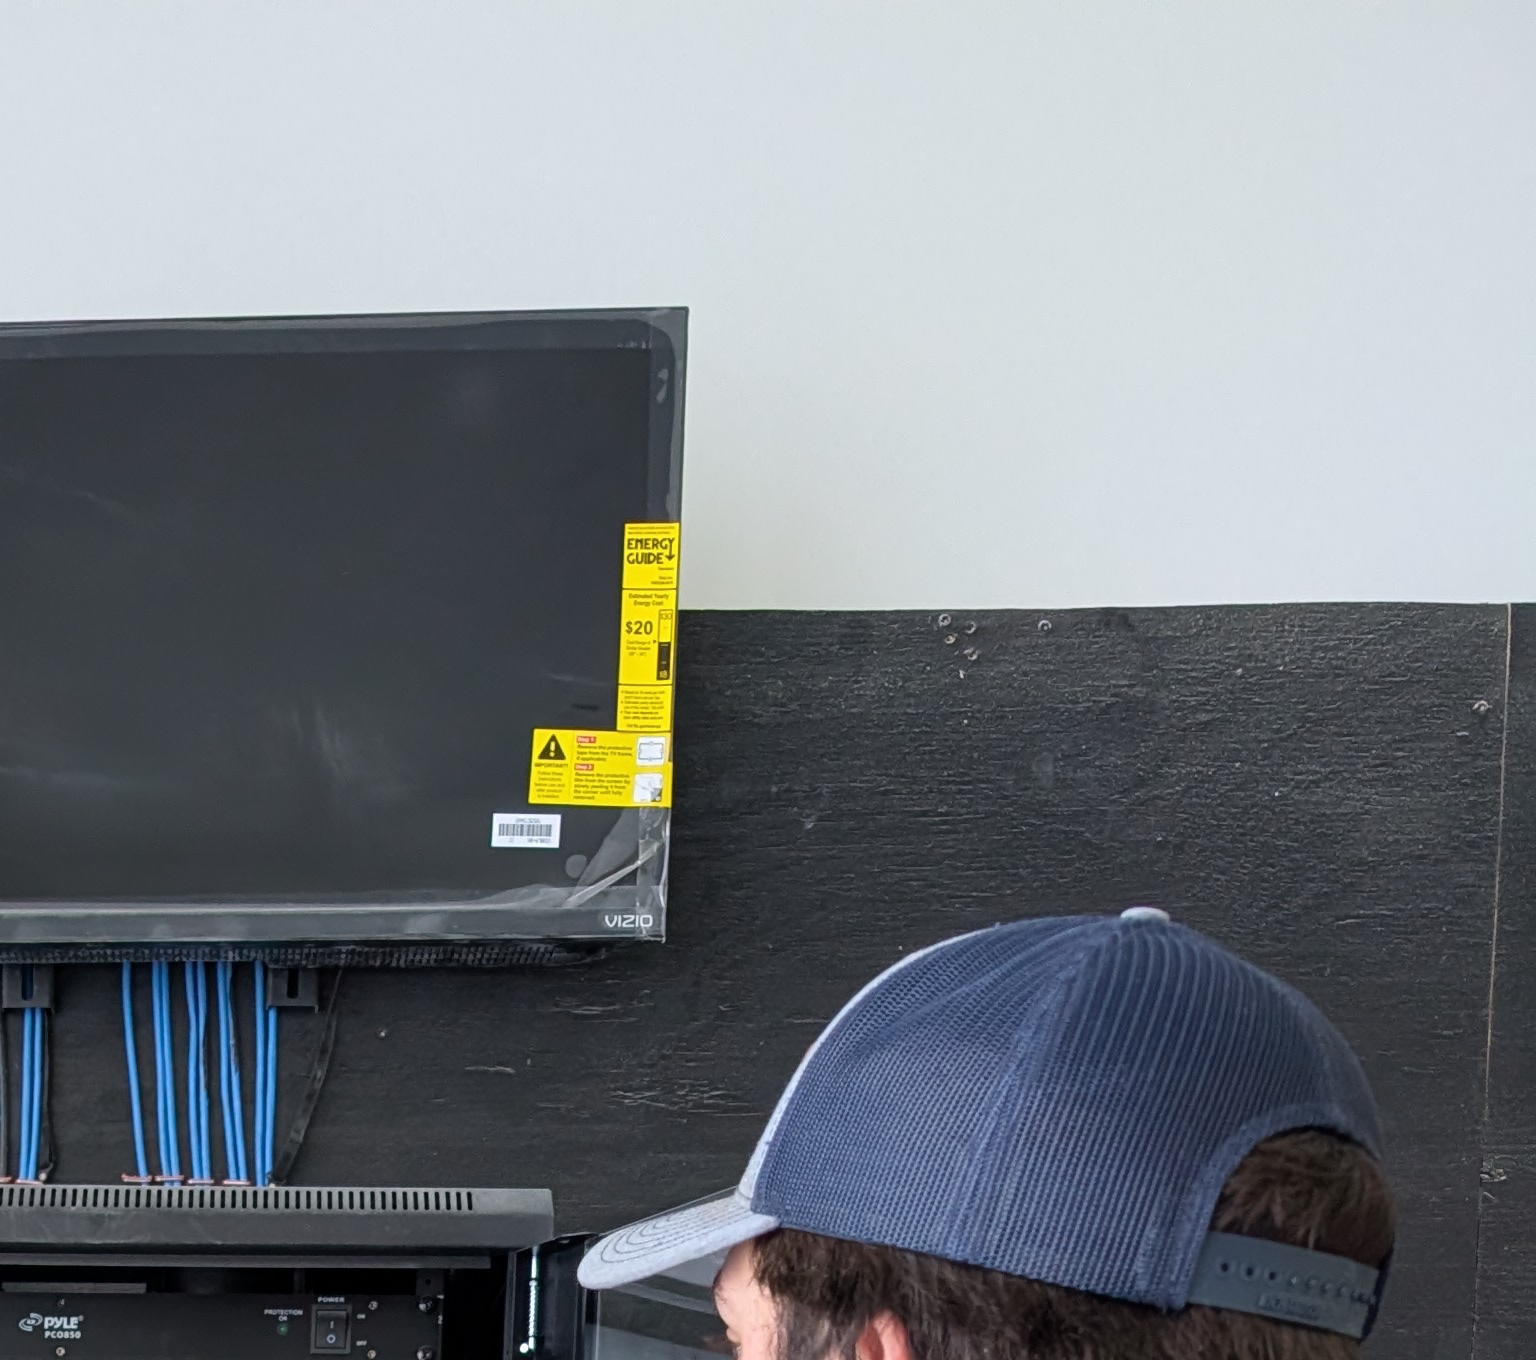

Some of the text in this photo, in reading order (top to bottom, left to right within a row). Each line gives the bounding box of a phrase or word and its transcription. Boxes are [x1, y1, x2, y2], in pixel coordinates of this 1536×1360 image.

[627, 538, 676, 550] ENERGY
[627, 552, 664, 565] GUIDE
[625, 620, 654, 636] $20
[605, 915, 653, 928] VIZIO
[44, 1316, 79, 1329] PYLE
